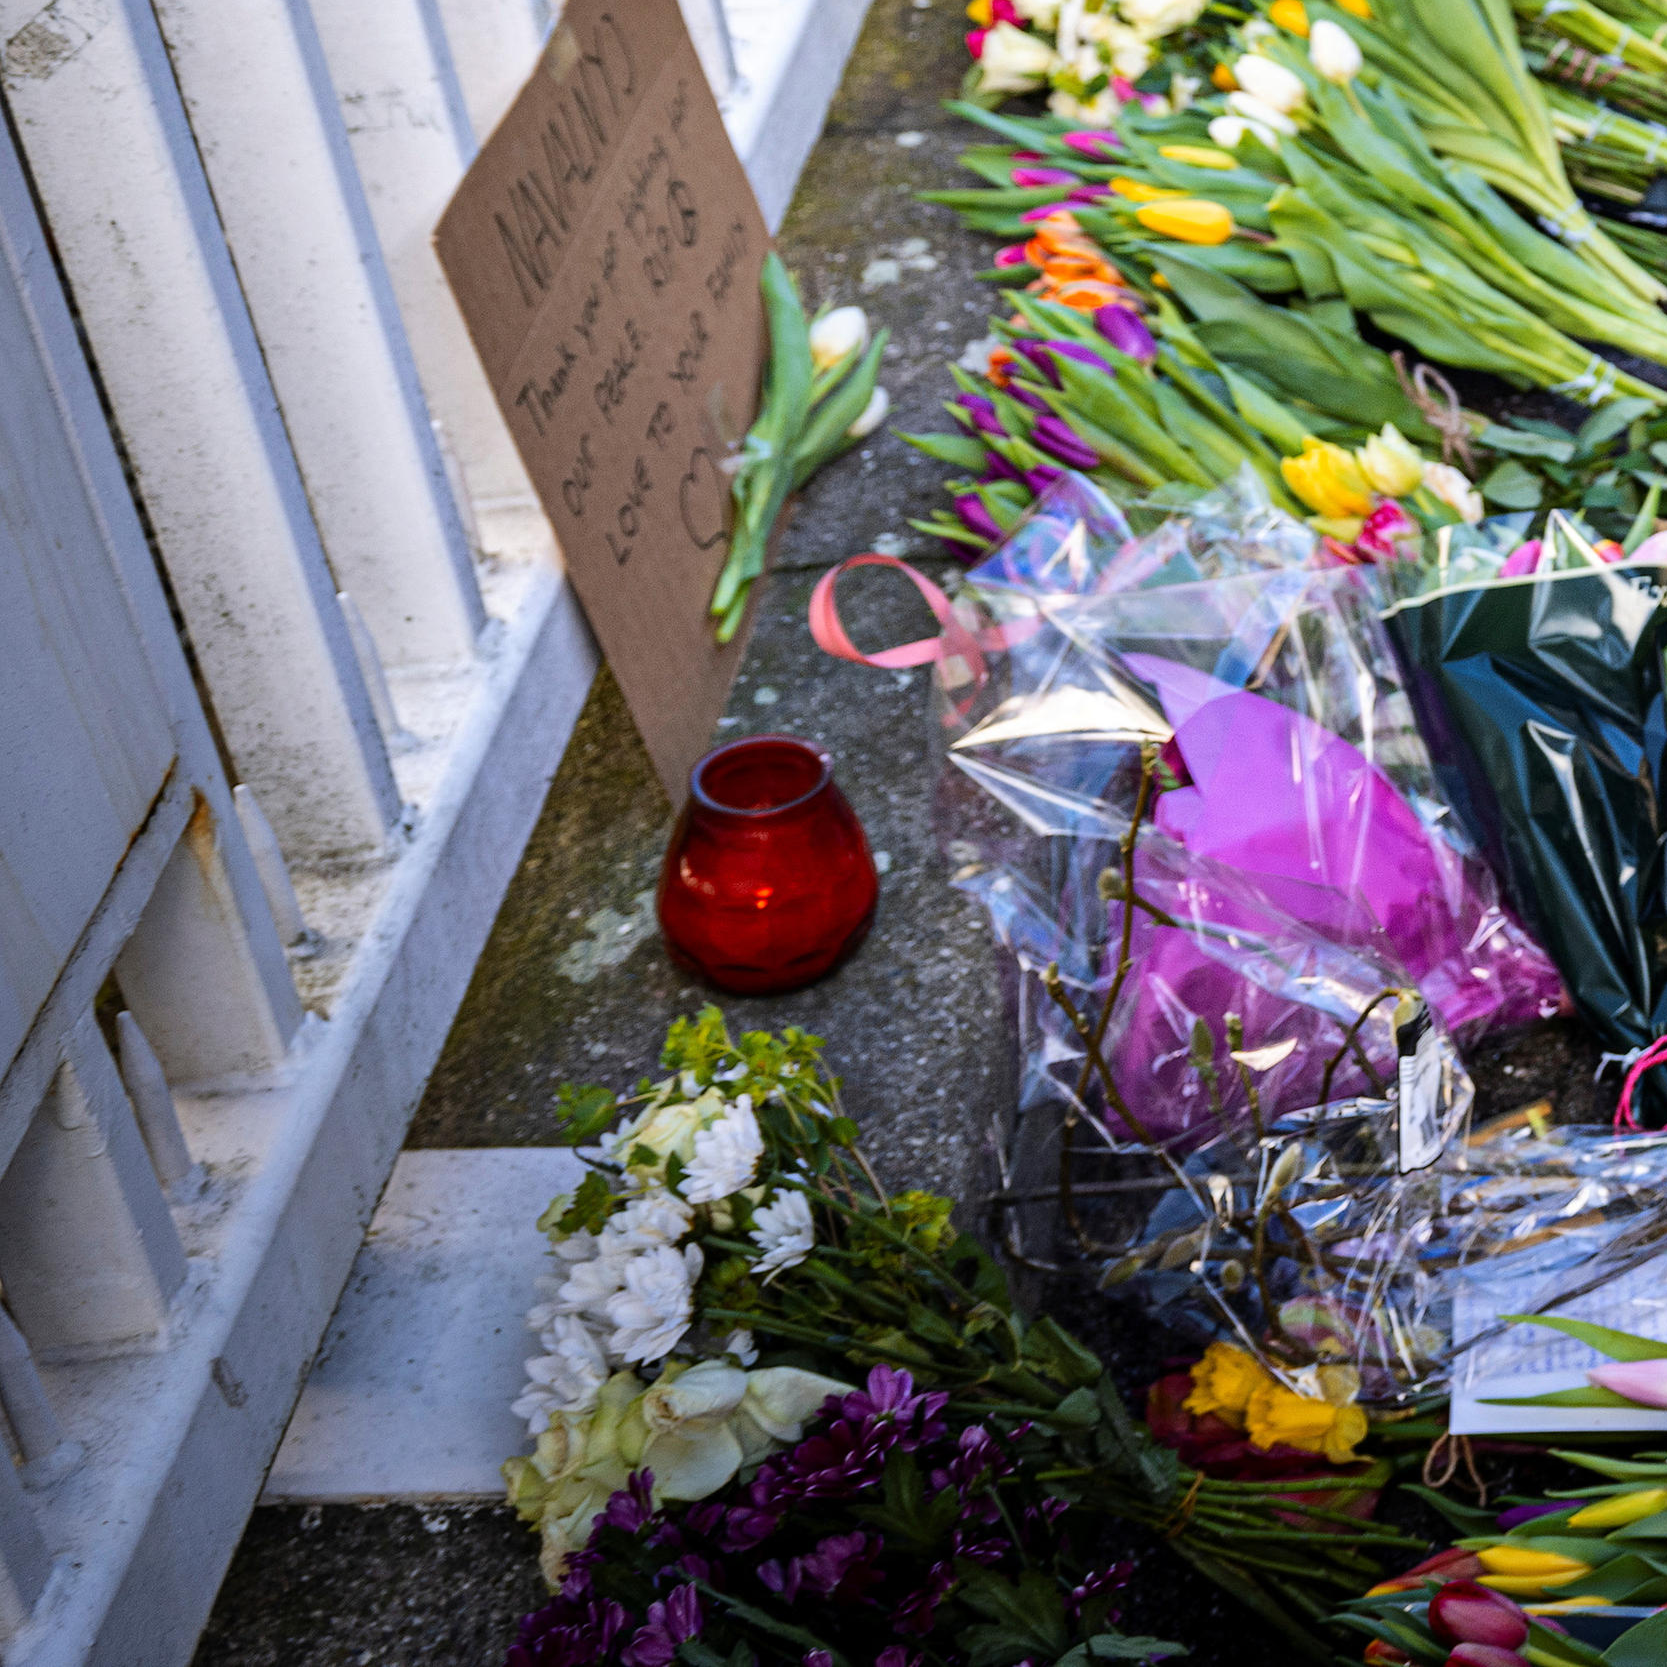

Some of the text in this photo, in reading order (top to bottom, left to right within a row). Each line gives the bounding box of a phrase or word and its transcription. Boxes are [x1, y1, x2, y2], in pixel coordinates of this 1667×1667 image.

[515, 342, 577, 437] Thank
[574, 282, 600, 355] you
[647, 401, 675, 451] TO
